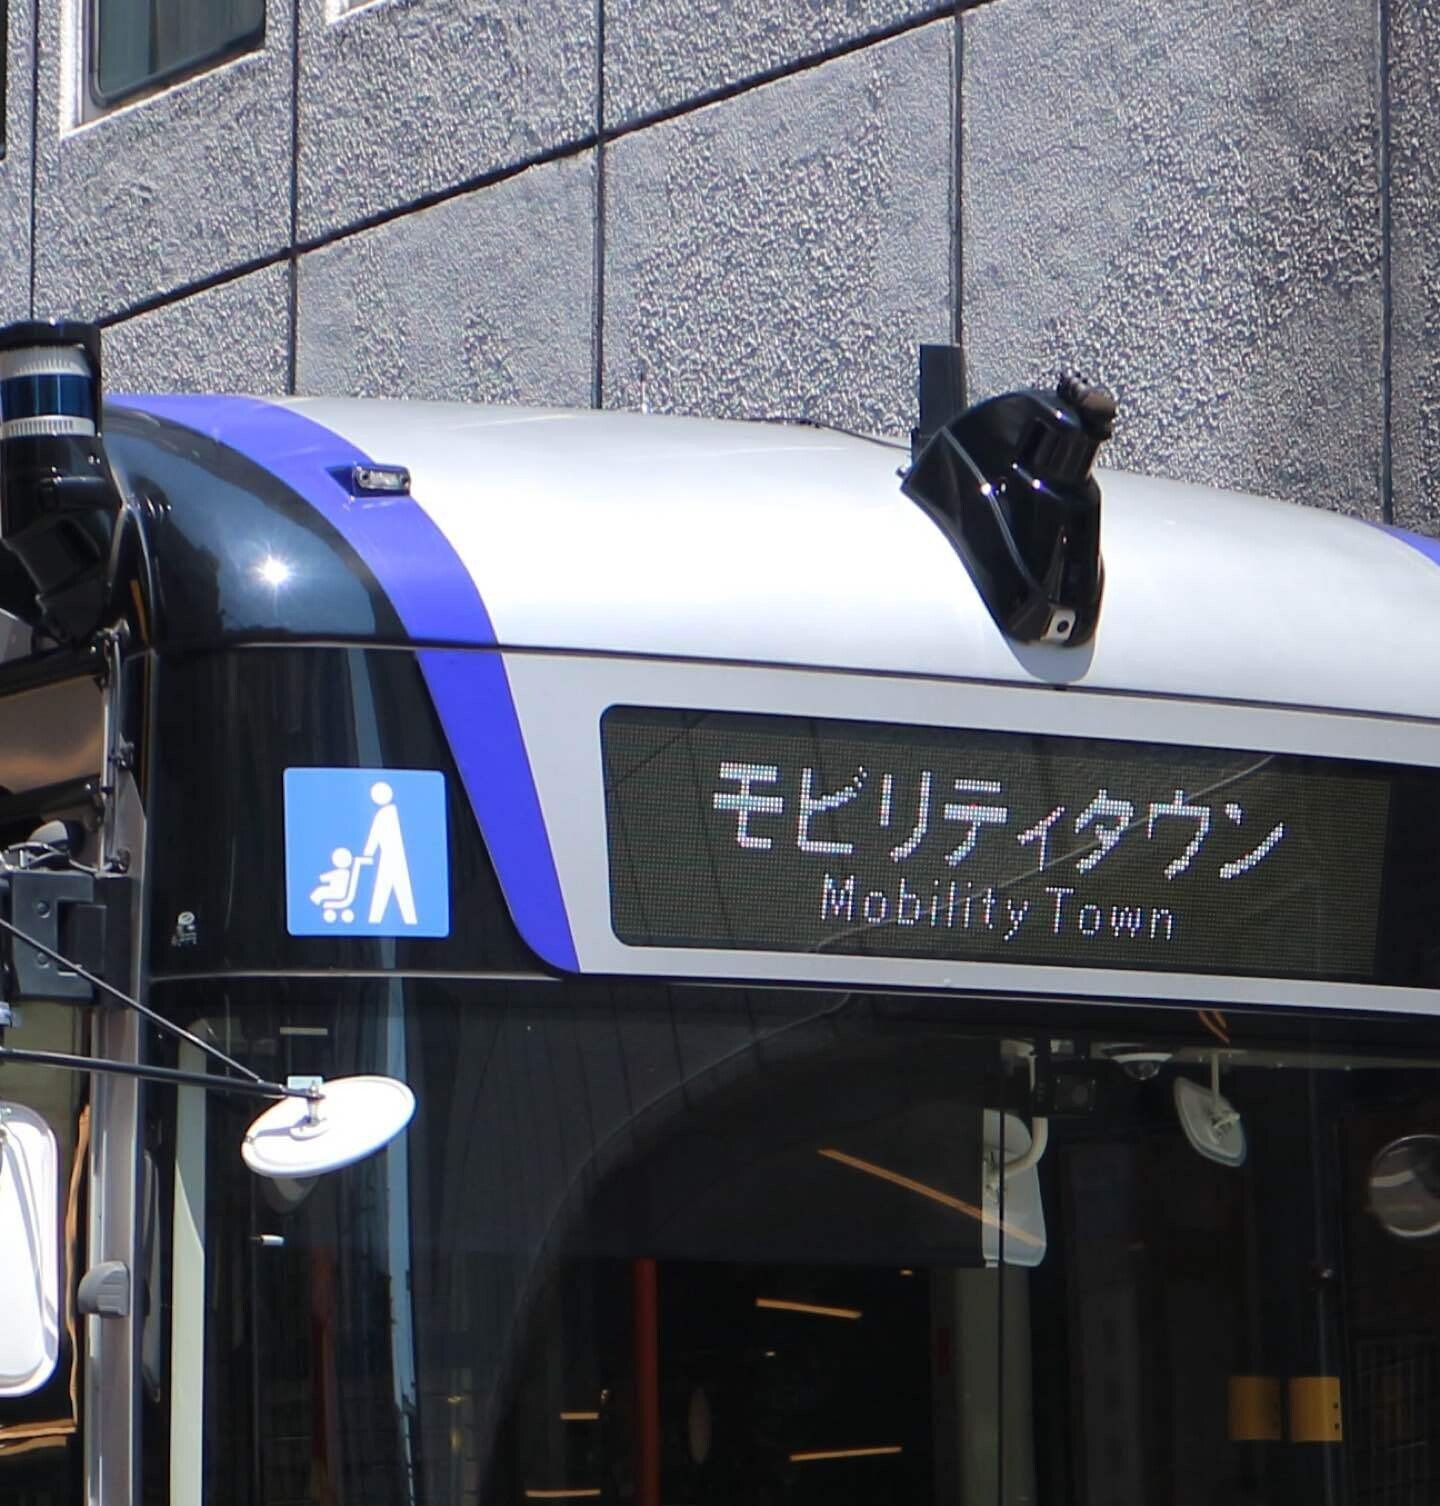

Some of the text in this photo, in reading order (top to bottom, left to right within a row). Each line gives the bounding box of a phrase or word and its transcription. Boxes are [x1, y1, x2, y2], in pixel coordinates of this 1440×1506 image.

[713, 762, 1285, 881] モビリティタウン
[819, 876, 1175, 941] Mobility Town
